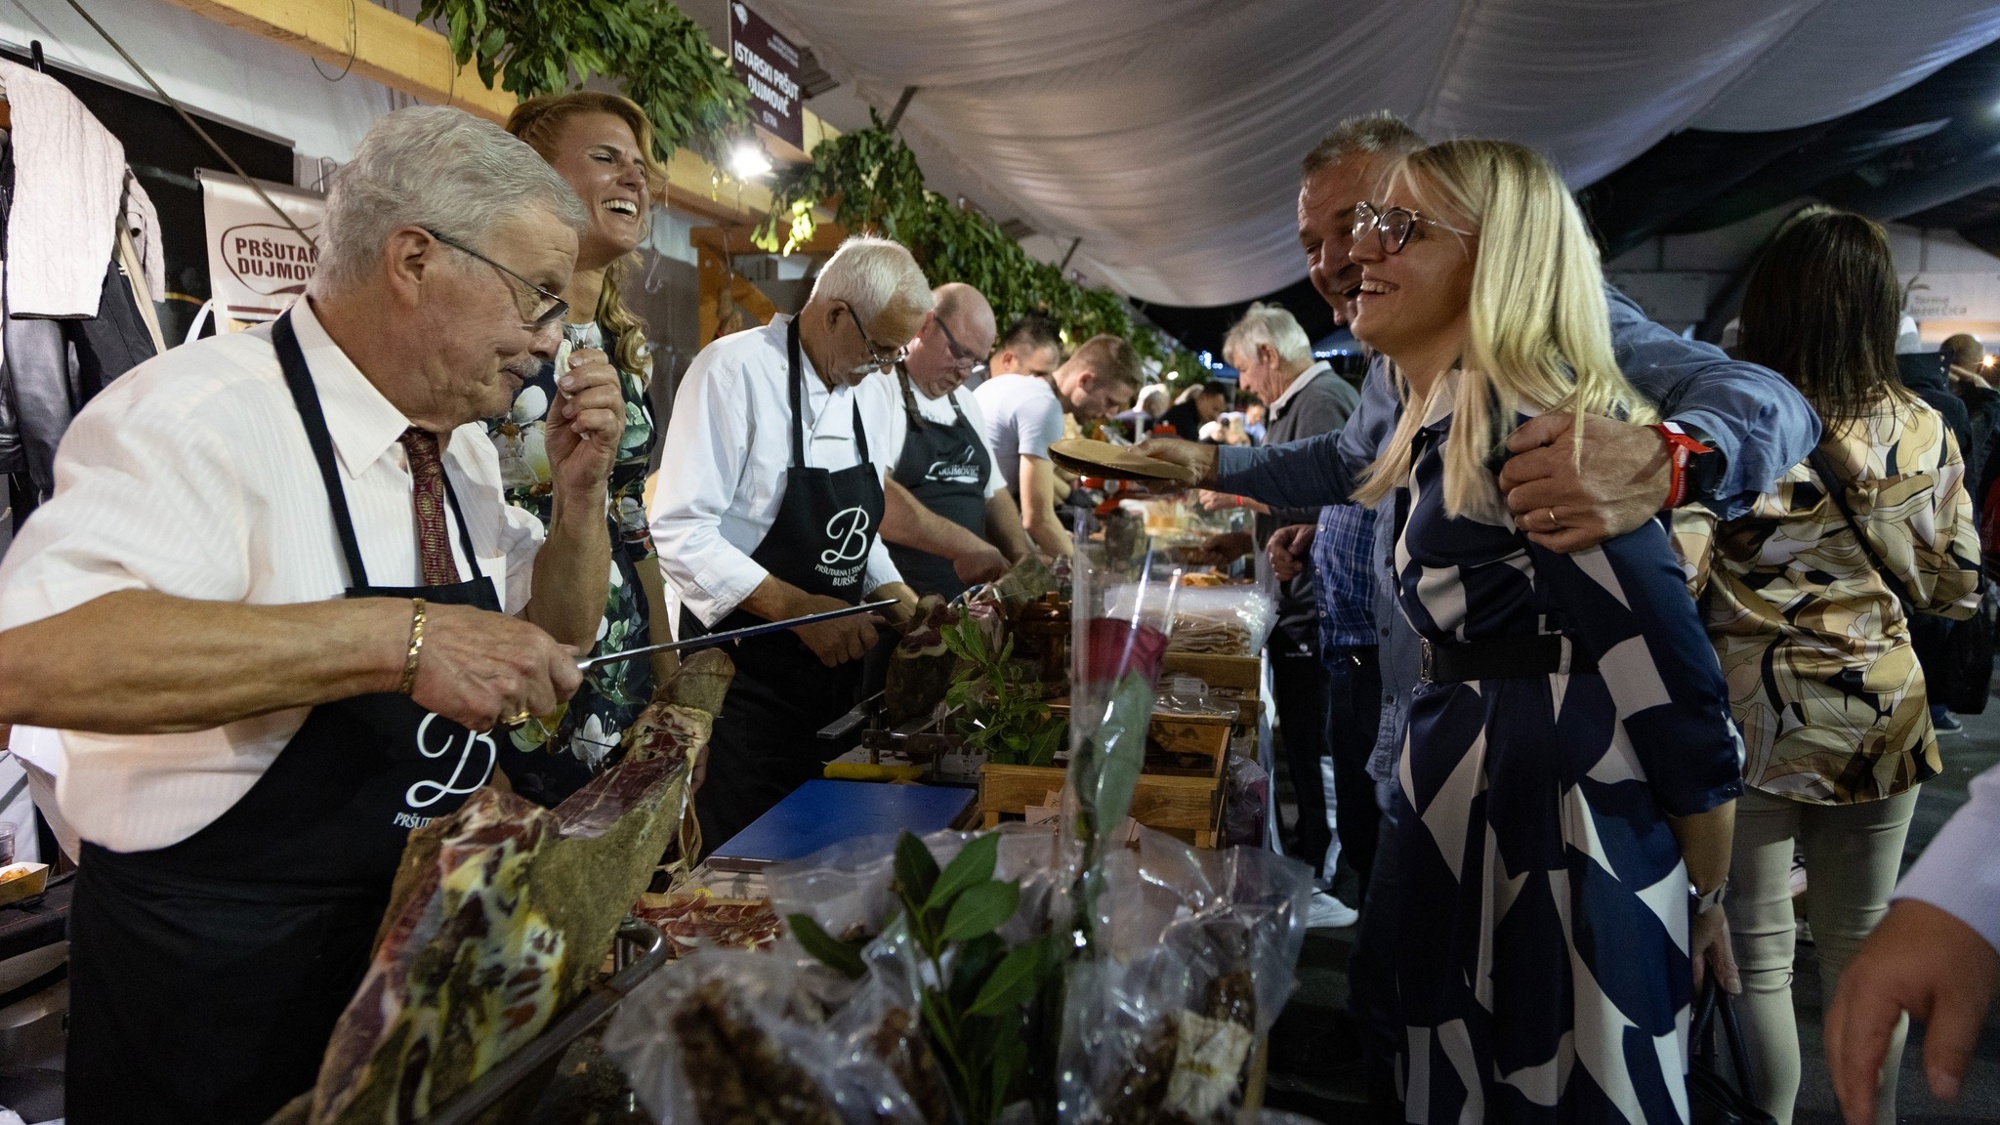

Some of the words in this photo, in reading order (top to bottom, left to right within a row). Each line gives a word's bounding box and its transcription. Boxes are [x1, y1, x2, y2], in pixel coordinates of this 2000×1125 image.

[734, 39, 773, 84] ISTARSKI
[773, 68, 799, 101] PRŠUT
[820, 505, 870, 564] B
